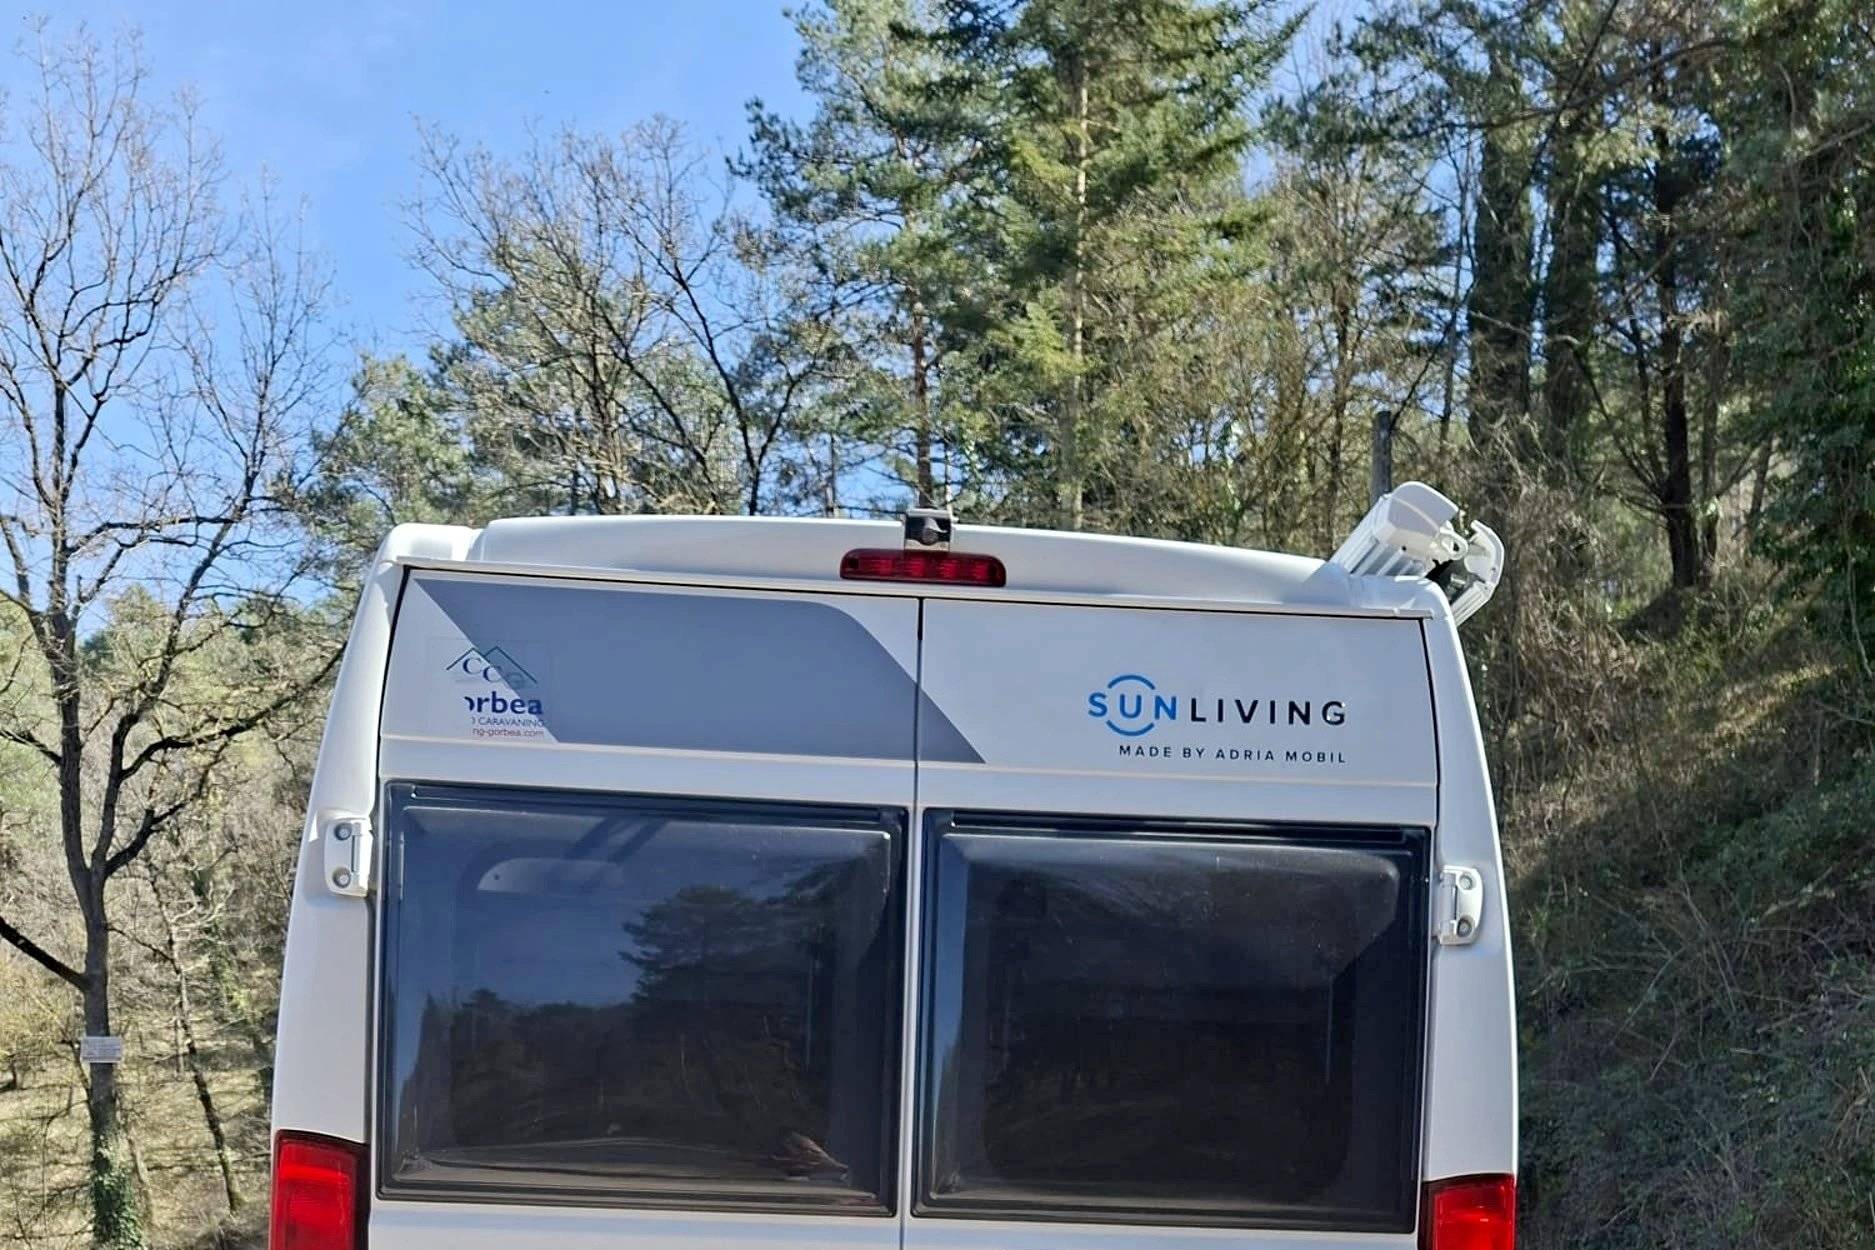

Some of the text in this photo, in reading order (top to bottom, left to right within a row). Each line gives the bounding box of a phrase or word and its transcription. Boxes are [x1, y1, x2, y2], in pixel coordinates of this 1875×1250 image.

[479, 717, 544, 727] CARAVANING
[1119, 745, 1346, 763] MADE BY ADRIA MOBIL
